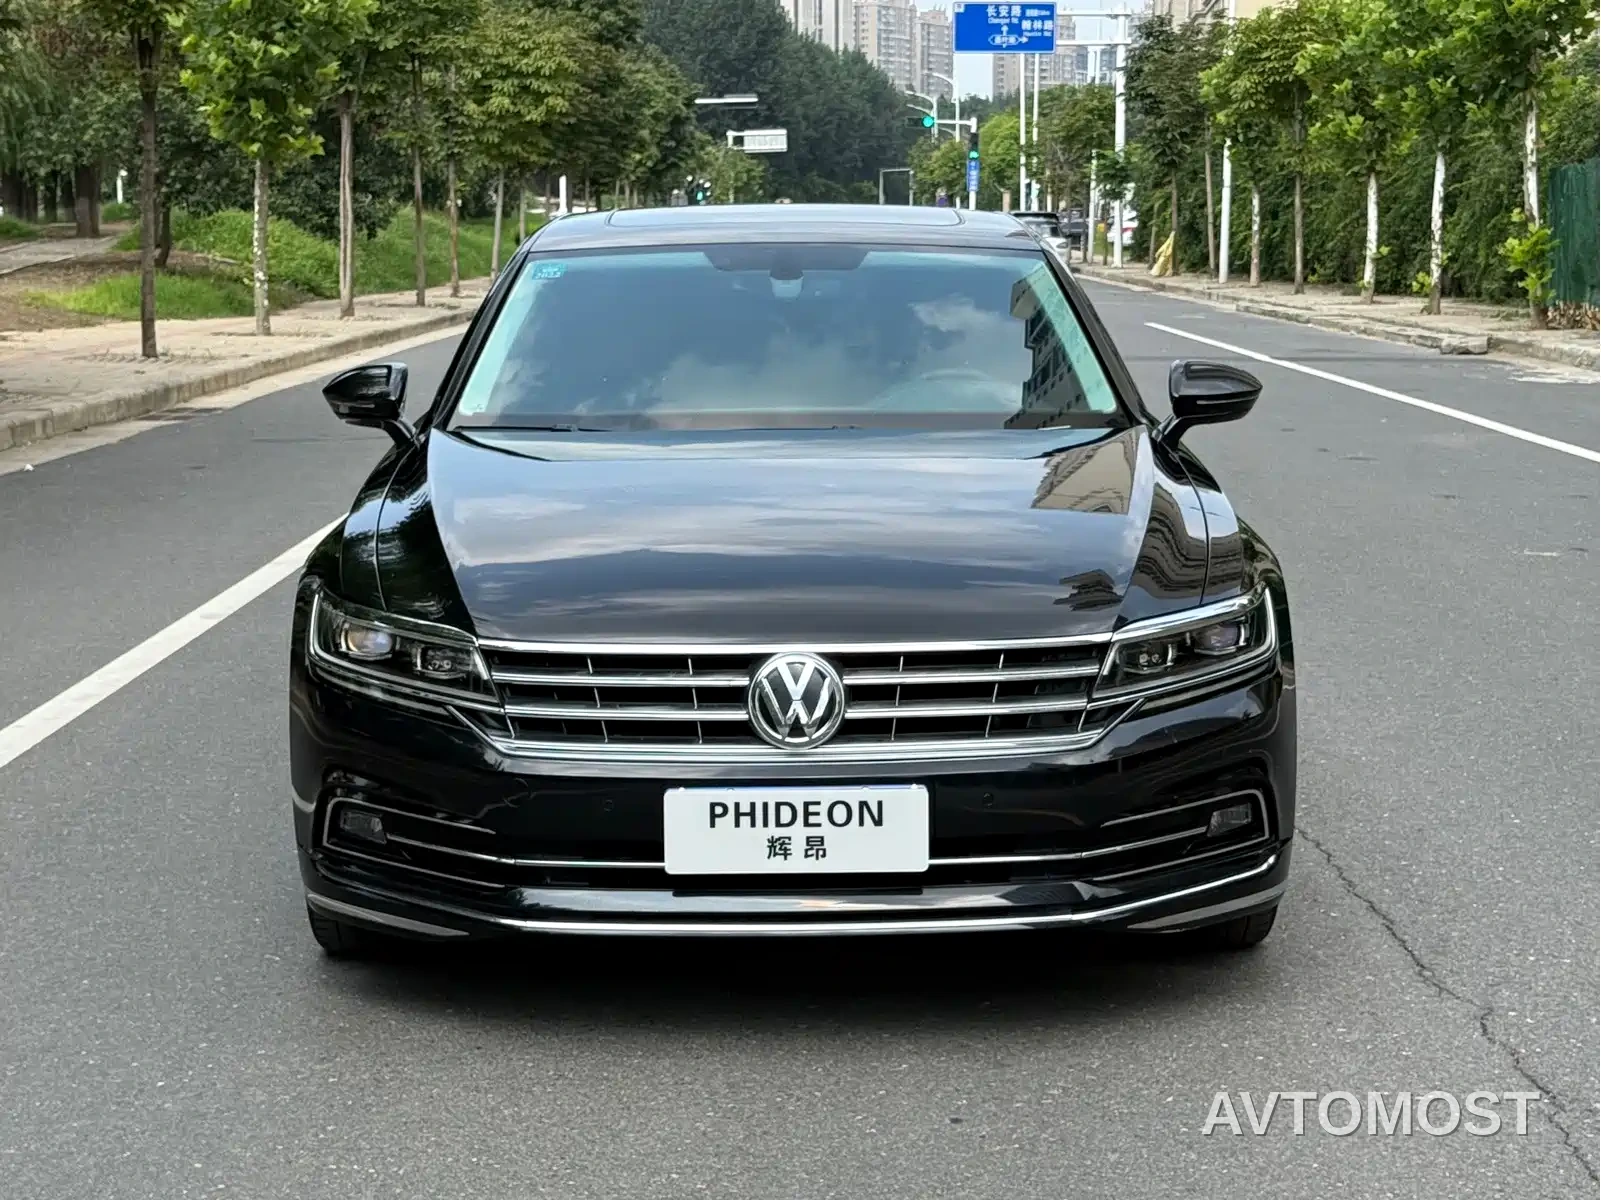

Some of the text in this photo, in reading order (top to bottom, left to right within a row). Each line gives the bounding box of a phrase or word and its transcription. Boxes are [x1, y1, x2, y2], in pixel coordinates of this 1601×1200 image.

[987, 5, 1021, 17] 长安路
[752, 656, 839, 746] VW
[709, 800, 884, 828] PHIDEON
[766, 835, 827, 861] 辉昂
